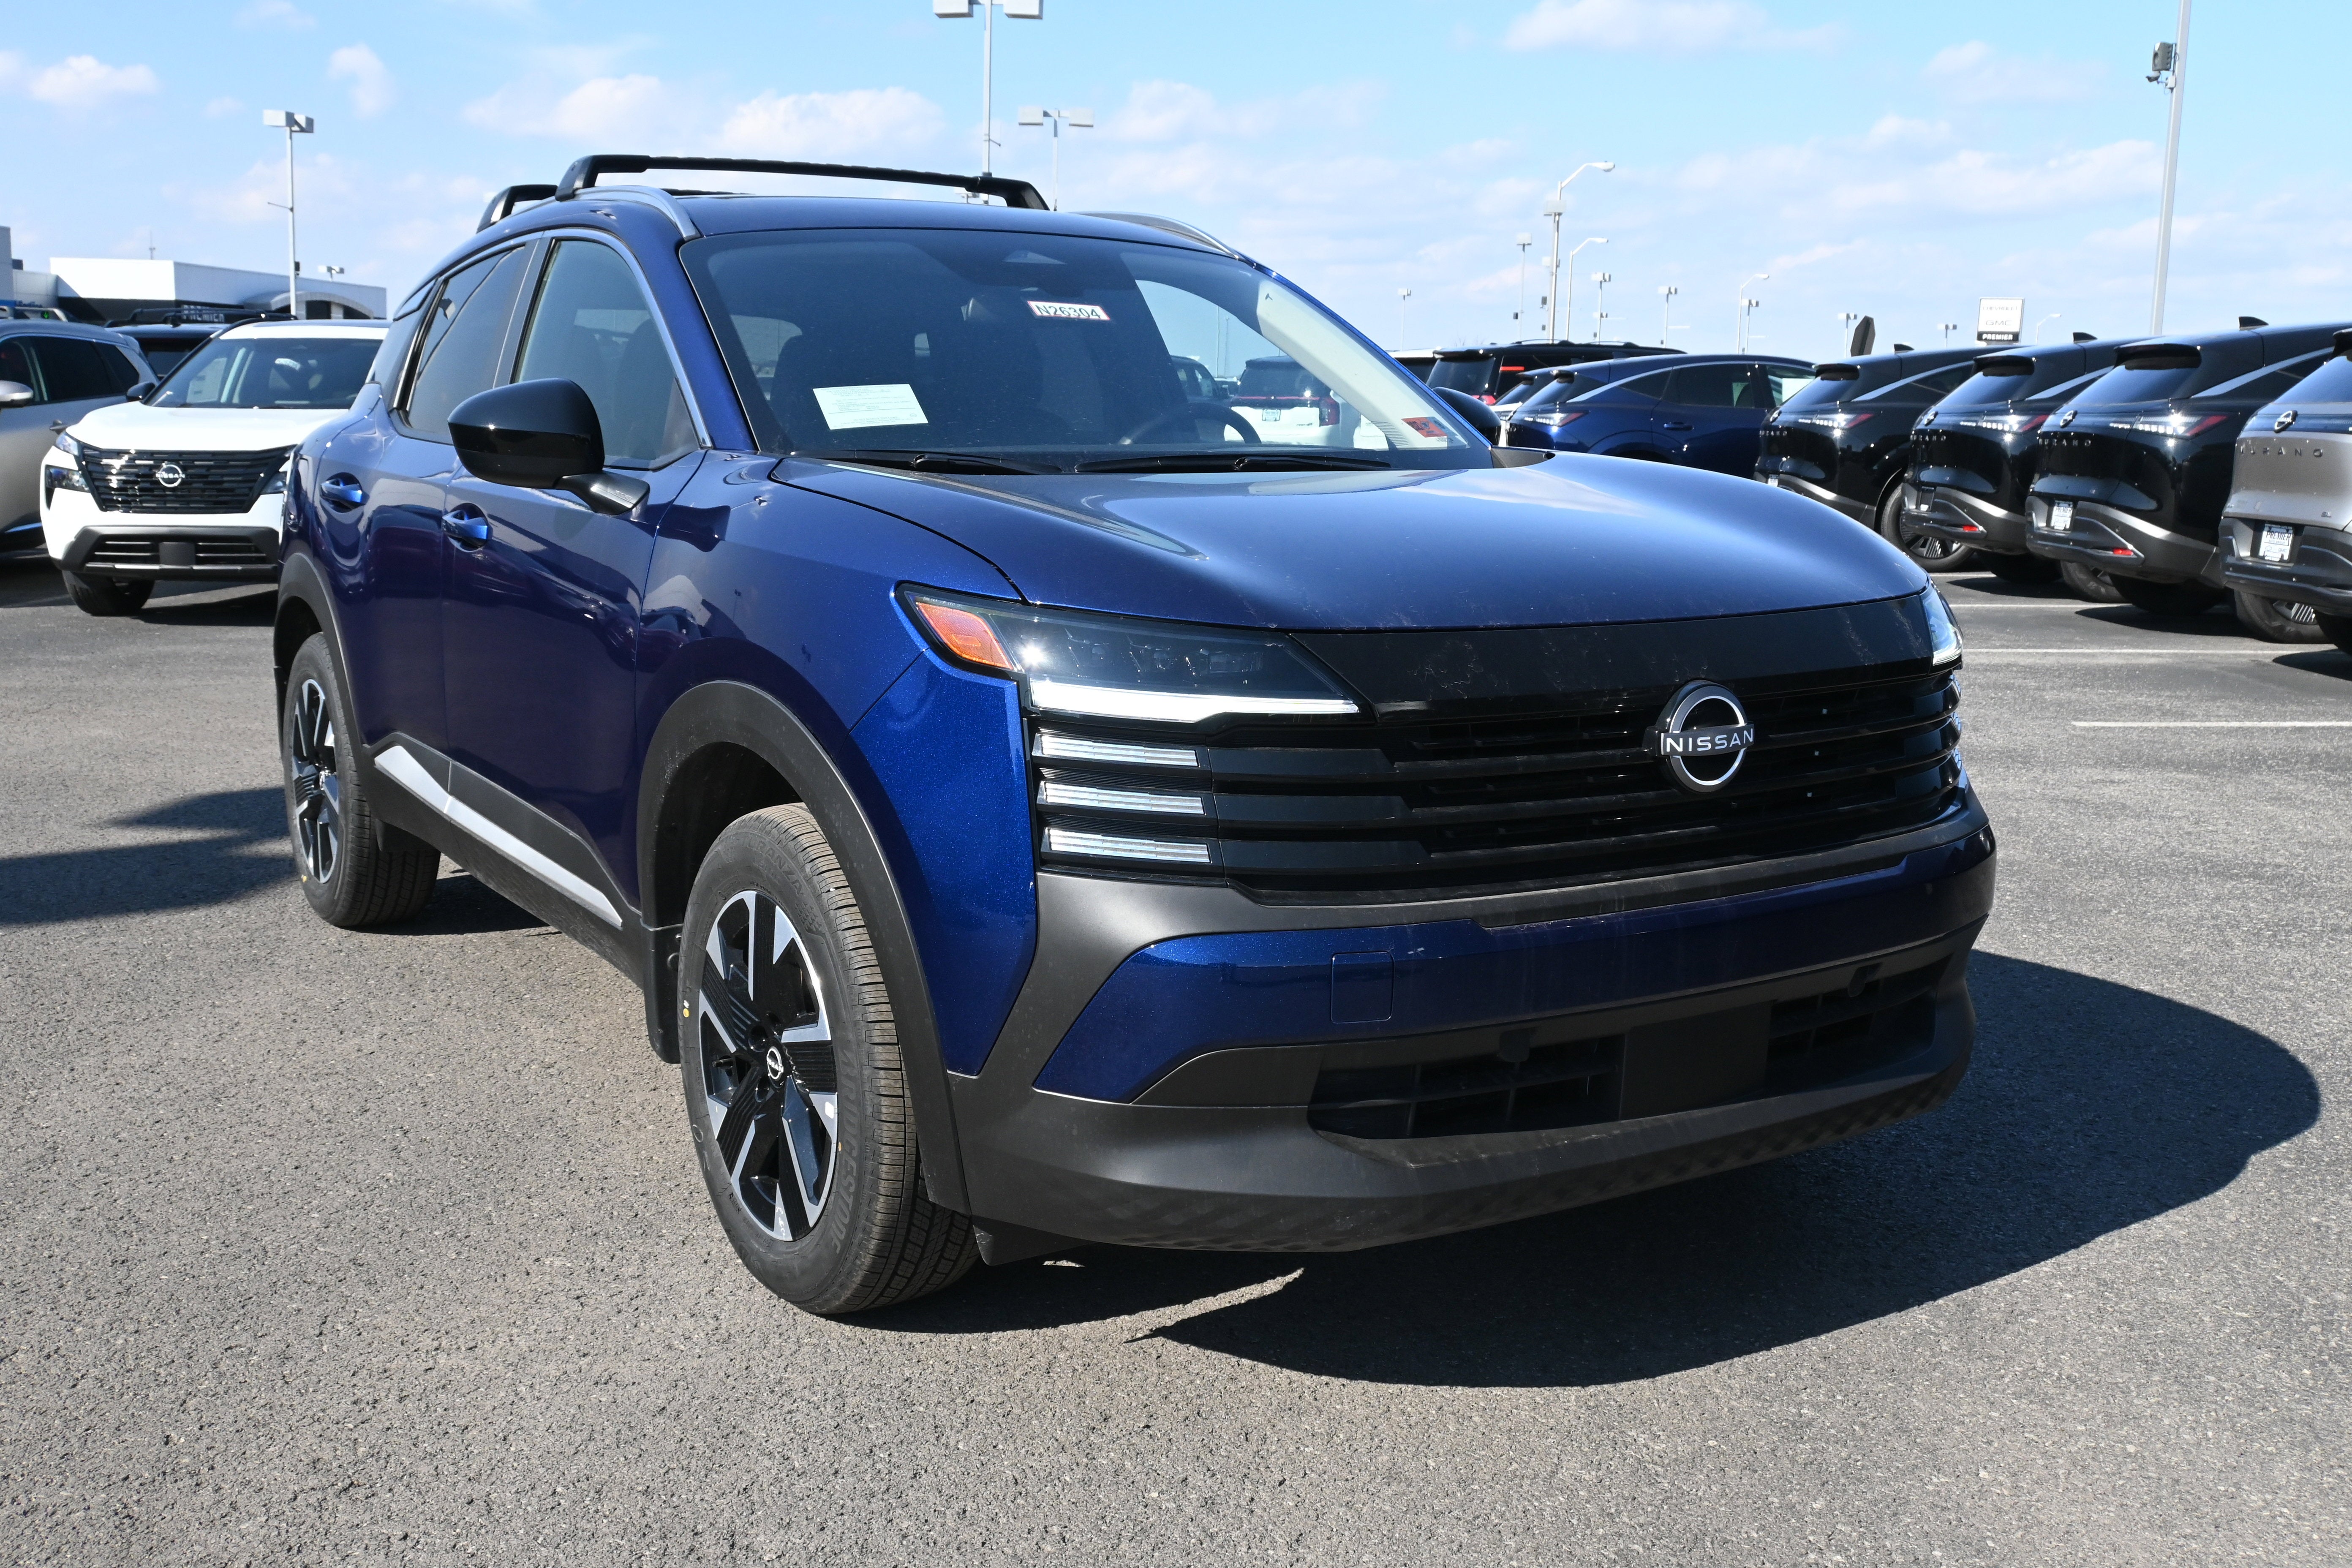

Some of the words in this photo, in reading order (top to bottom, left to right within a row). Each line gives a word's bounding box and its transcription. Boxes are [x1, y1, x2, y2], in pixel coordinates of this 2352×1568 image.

[1035, 304, 1101, 318] N26304
[2266, 530, 2291, 541] PREMIER
[1666, 728, 1753, 752] NISSAN
[831, 1049, 858, 1254] BRIDGESTONE
